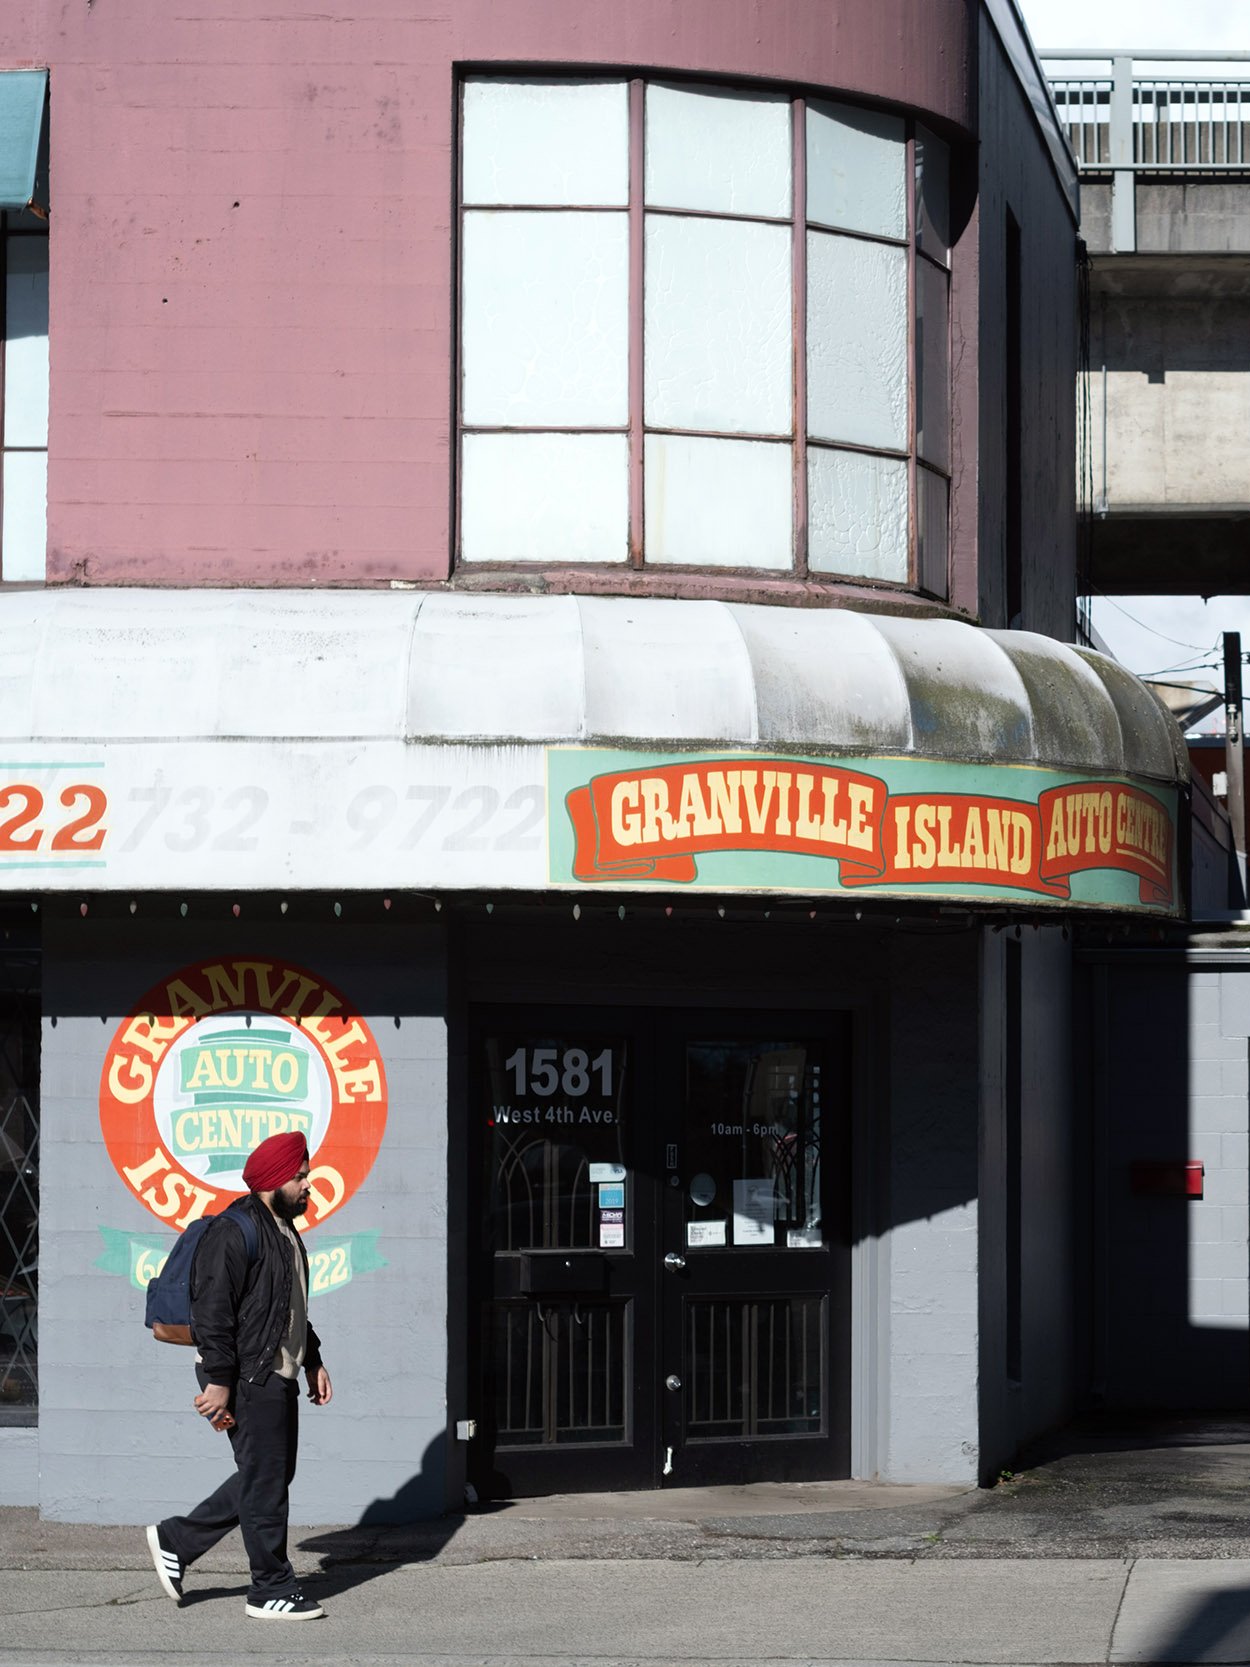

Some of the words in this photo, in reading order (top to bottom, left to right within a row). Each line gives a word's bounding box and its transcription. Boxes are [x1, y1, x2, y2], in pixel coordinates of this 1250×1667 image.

[0, 784, 107, 851] 22
[118, 786, 269, 852] 732
[345, 785, 545, 852] 9722
[611, 771, 873, 853] GRANVILLE
[894, 804, 1032, 875] ISLAND
[1046, 790, 1112, 861] AUTO
[1116, 792, 1167, 864] CENTRE
[108, 962, 382, 1104] GRANVILLE
[186, 1049, 299, 1093] AUTO
[505, 1047, 613, 1097] 1581
[493, 1106, 541, 1123] West
[545, 1106, 574, 1123] 4th
[578, 1106, 618, 1123] Ave.
[711, 1122, 743, 1135] 10am
[753, 1122, 778, 1138] 6pm
[123, 1147, 344, 1230] ISLD
